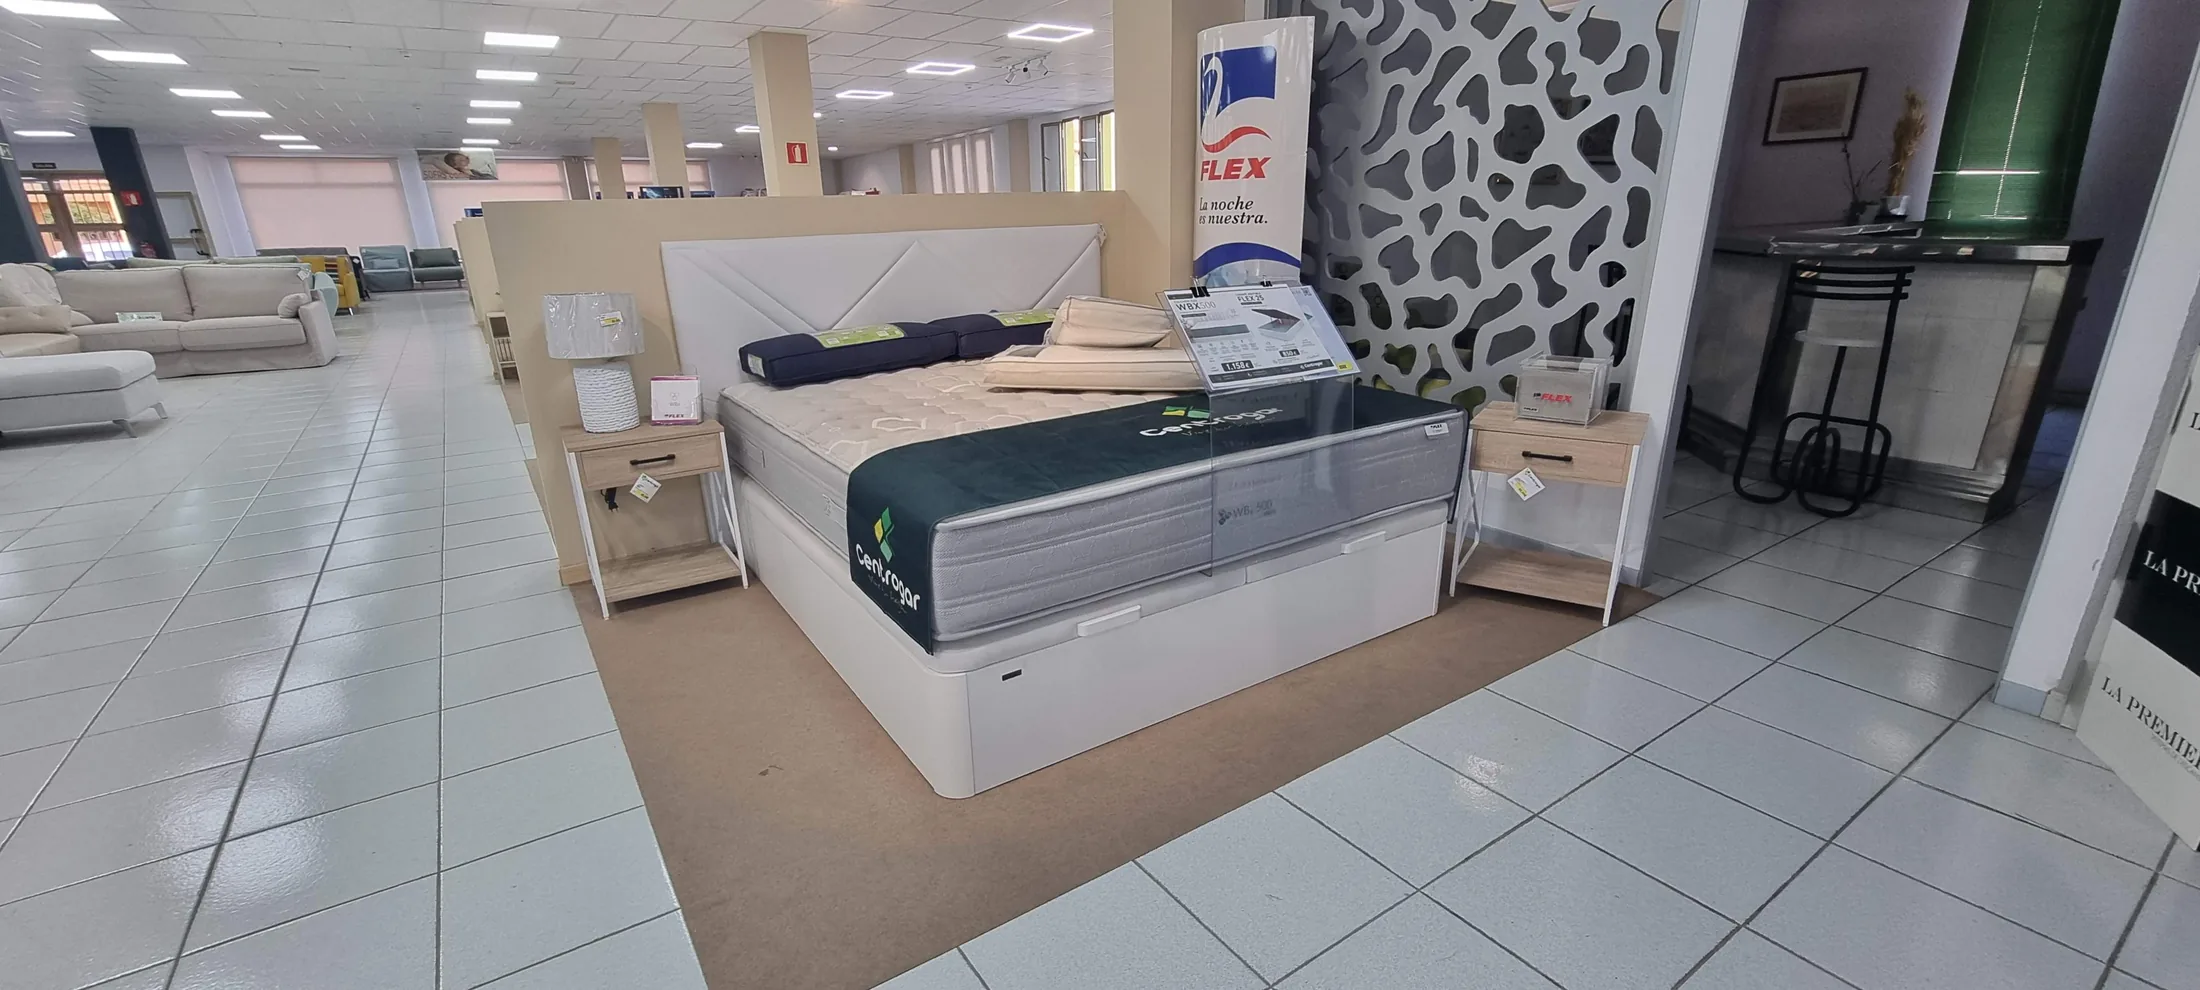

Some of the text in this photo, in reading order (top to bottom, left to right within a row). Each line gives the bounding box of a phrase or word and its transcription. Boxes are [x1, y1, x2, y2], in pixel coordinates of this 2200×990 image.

[1200, 157, 1271, 181] FLEX
[1199, 195, 1254, 211] La noche
[1199, 212, 1268, 225] es nuestra.
[1237, 295, 1255, 303] FLEX
[1541, 391, 1573, 403] FLEX
[1139, 407, 1284, 437] Centrogar
[854, 543, 921, 611] Centrogar
[2143, 550, 2200, 597] LA PR
[2101, 676, 2123, 704] LA
